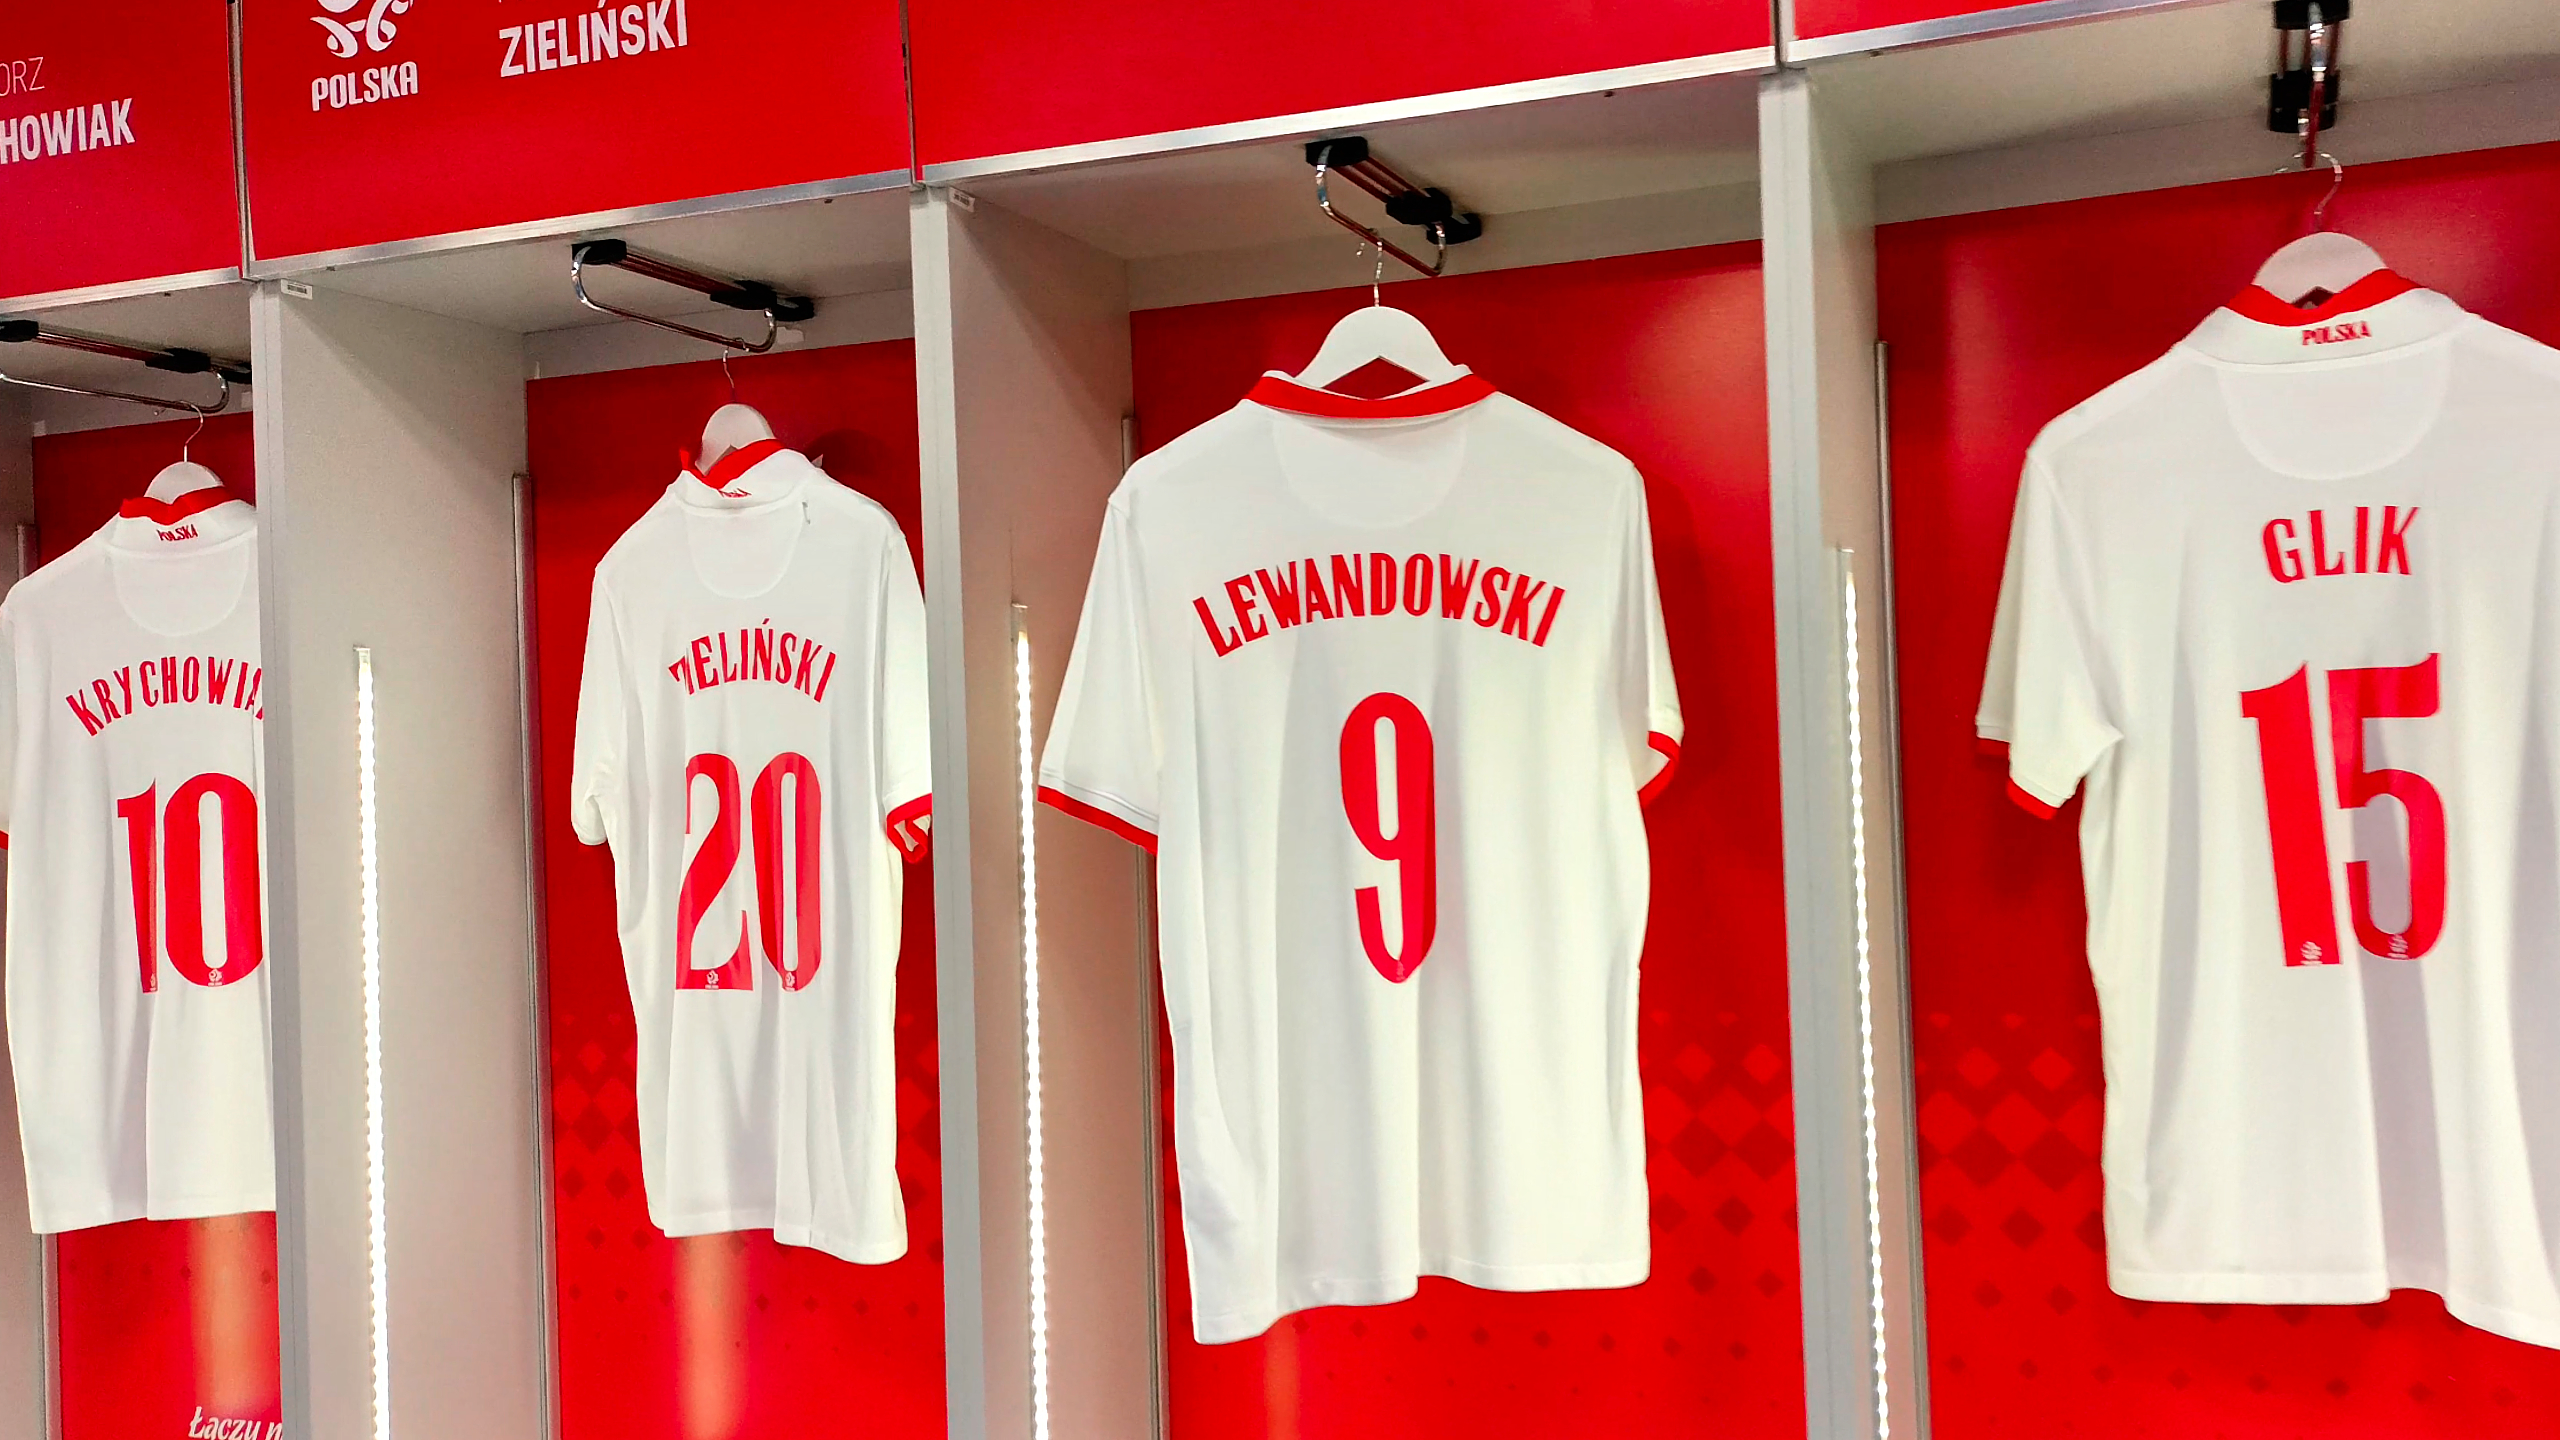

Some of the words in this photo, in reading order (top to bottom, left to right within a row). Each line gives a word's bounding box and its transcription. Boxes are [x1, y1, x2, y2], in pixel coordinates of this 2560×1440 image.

[498, 0, 689, 78] ZIELIŃSKI
[311, 61, 419, 112] POLSKA
[0, 97, 136, 165] HOWIAK
[2301, 320, 2372, 347] POLSKA
[156, 523, 199, 542] POLSKA
[2261, 504, 2421, 585] GLIK
[1192, 552, 1566, 658] LEWANDOWSKI
[1338, 691, 1438, 985] 9
[2238, 651, 2449, 968] 15
[115, 771, 265, 995] 10
[674, 751, 823, 992] 20
